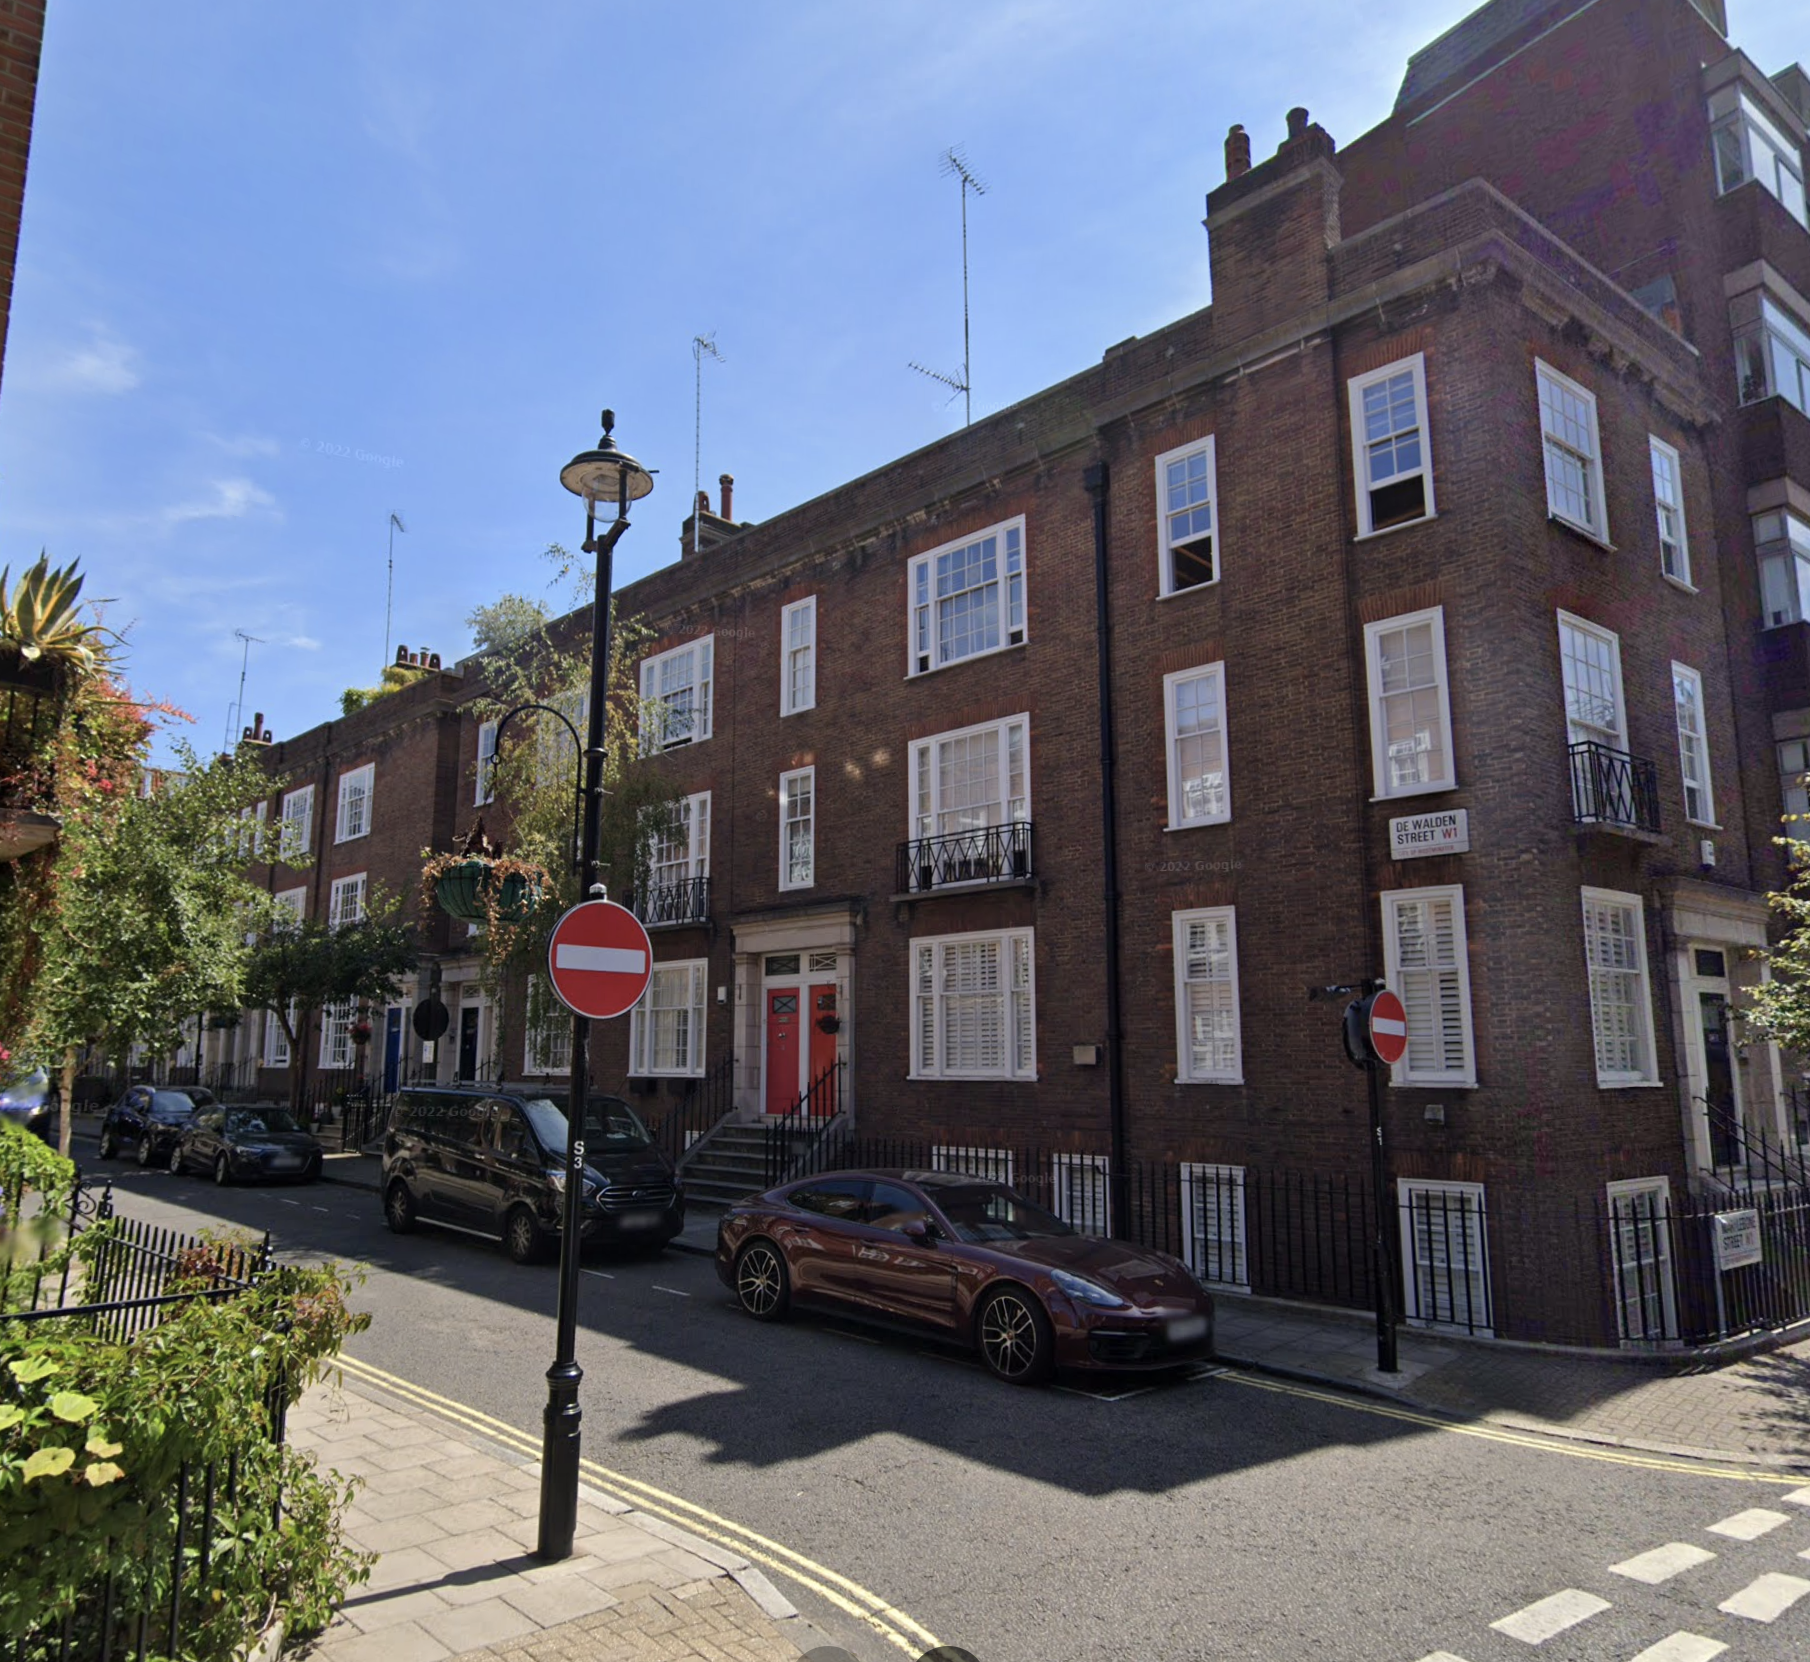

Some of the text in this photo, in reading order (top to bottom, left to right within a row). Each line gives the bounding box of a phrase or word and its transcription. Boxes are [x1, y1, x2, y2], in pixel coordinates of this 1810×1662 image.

[1396, 815, 1456, 833] DE WALDEN
[1397, 827, 1458, 845] STREET W1
